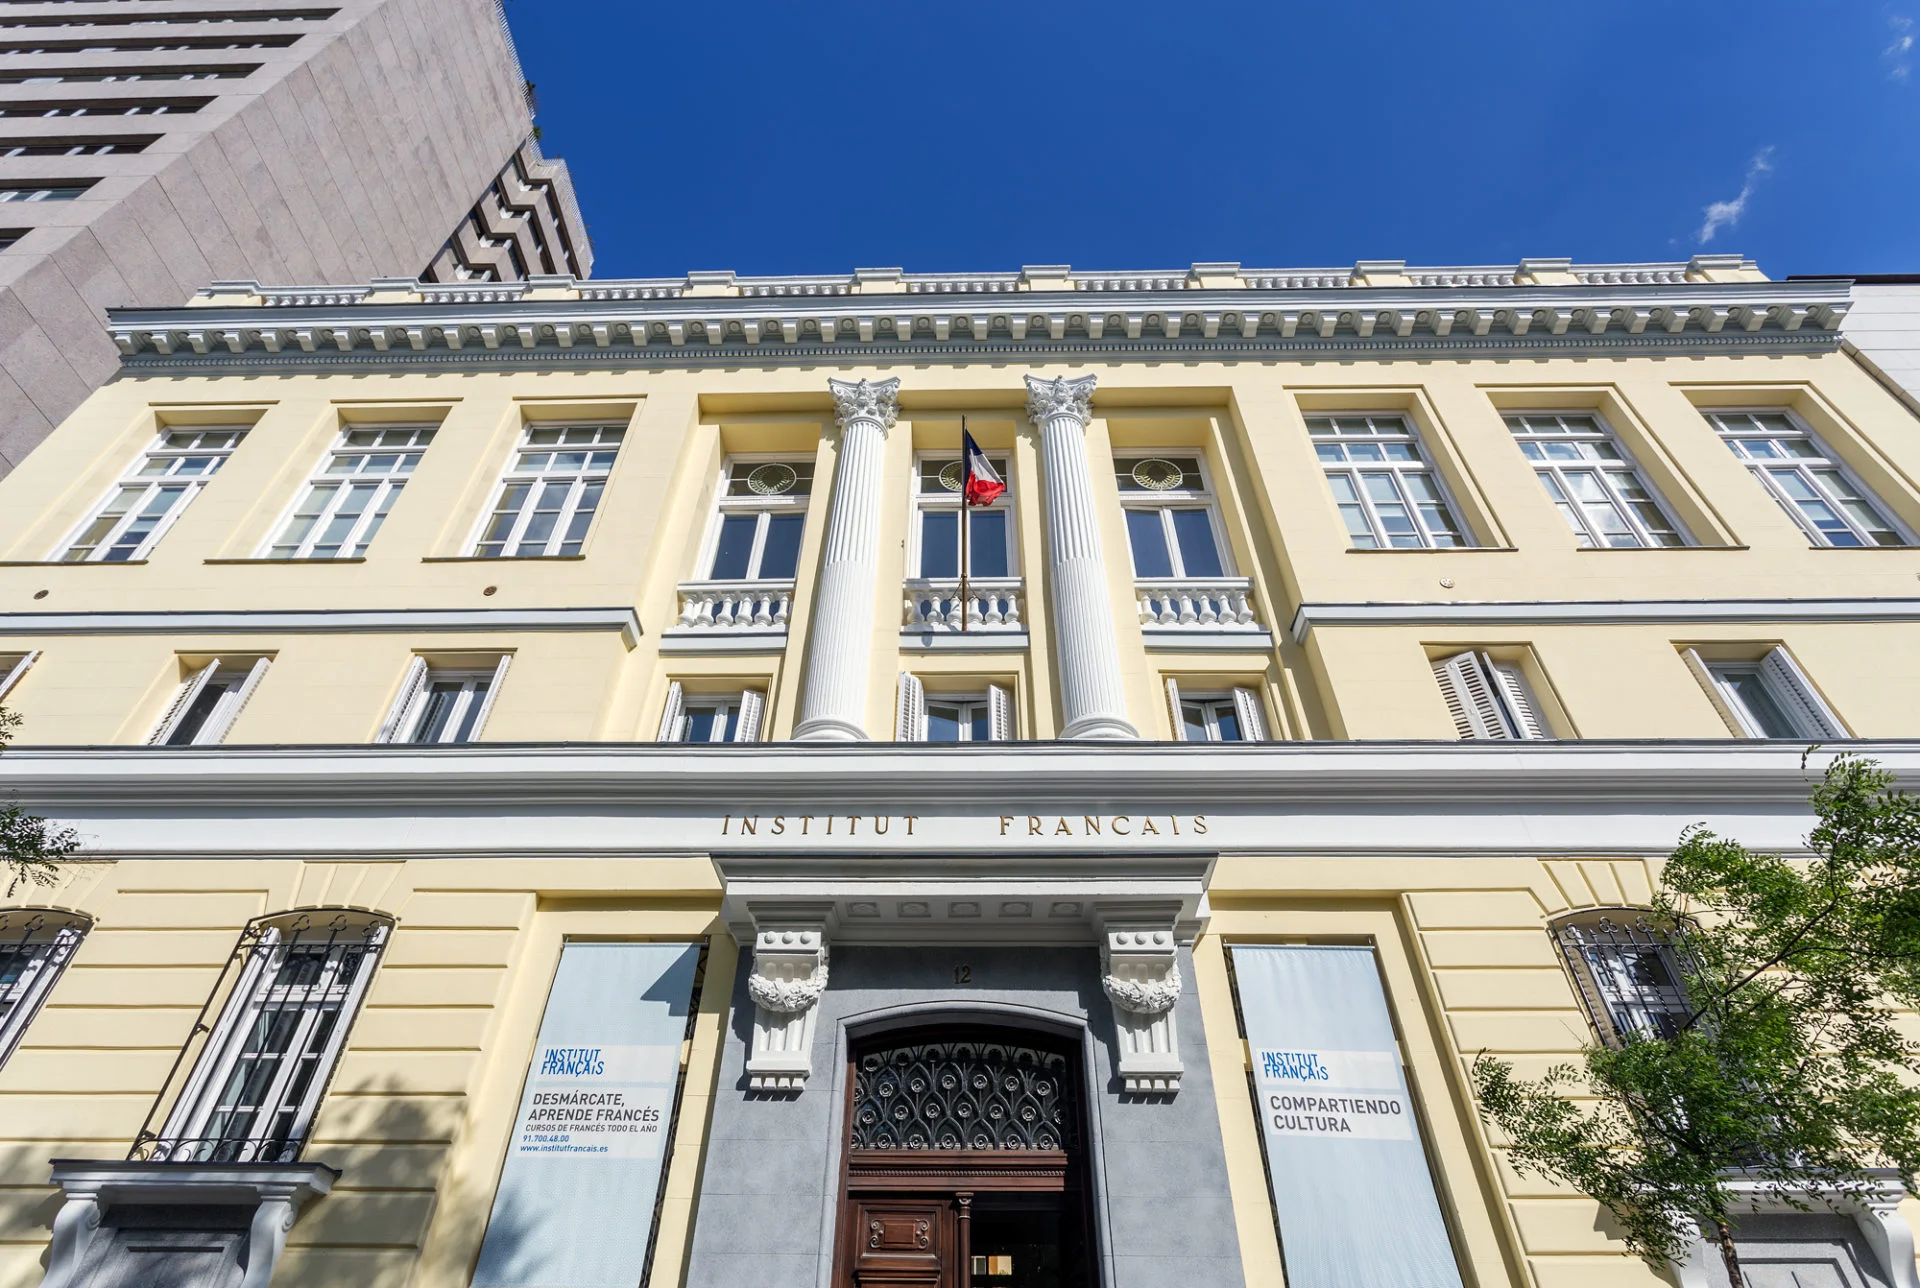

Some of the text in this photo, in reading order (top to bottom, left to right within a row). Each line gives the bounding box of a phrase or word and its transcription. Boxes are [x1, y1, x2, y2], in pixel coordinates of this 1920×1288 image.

[721, 814, 1209, 836] INSTITUT FRANCAIS
[954, 965, 973, 985] 12
[544, 1049, 602, 1063] INSTITUT
[1261, 1052, 1318, 1068] INSTITUT
[532, 1089, 625, 1107] DESMÁRCATE,
[1270, 1095, 1402, 1116] COMPARTIENDO
[527, 1105, 660, 1122] APRENDE FRANCÉS
[525, 1122, 658, 1133] CURSOS DE FRANCÉS TODO EL AÑO
[1273, 1115, 1352, 1133] CULTURA
